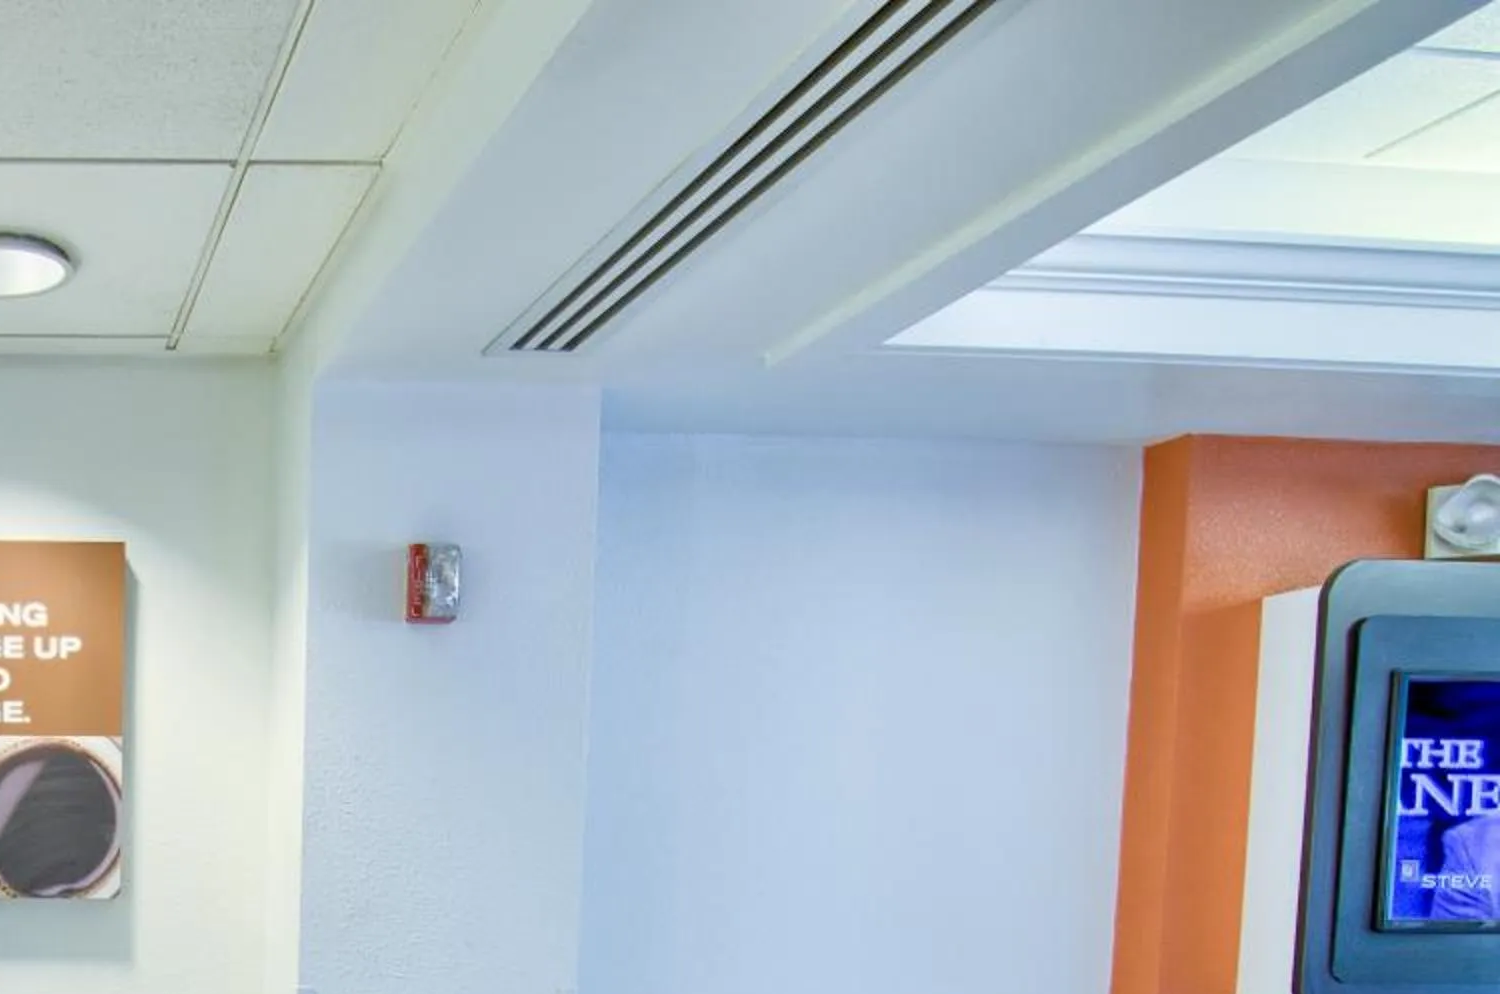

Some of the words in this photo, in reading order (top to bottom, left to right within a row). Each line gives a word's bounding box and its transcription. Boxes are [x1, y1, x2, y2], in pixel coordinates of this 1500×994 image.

[33, 636, 82, 660] UP
[1401, 738, 1484, 769] THE
[1421, 873, 1493, 889] STEVE
